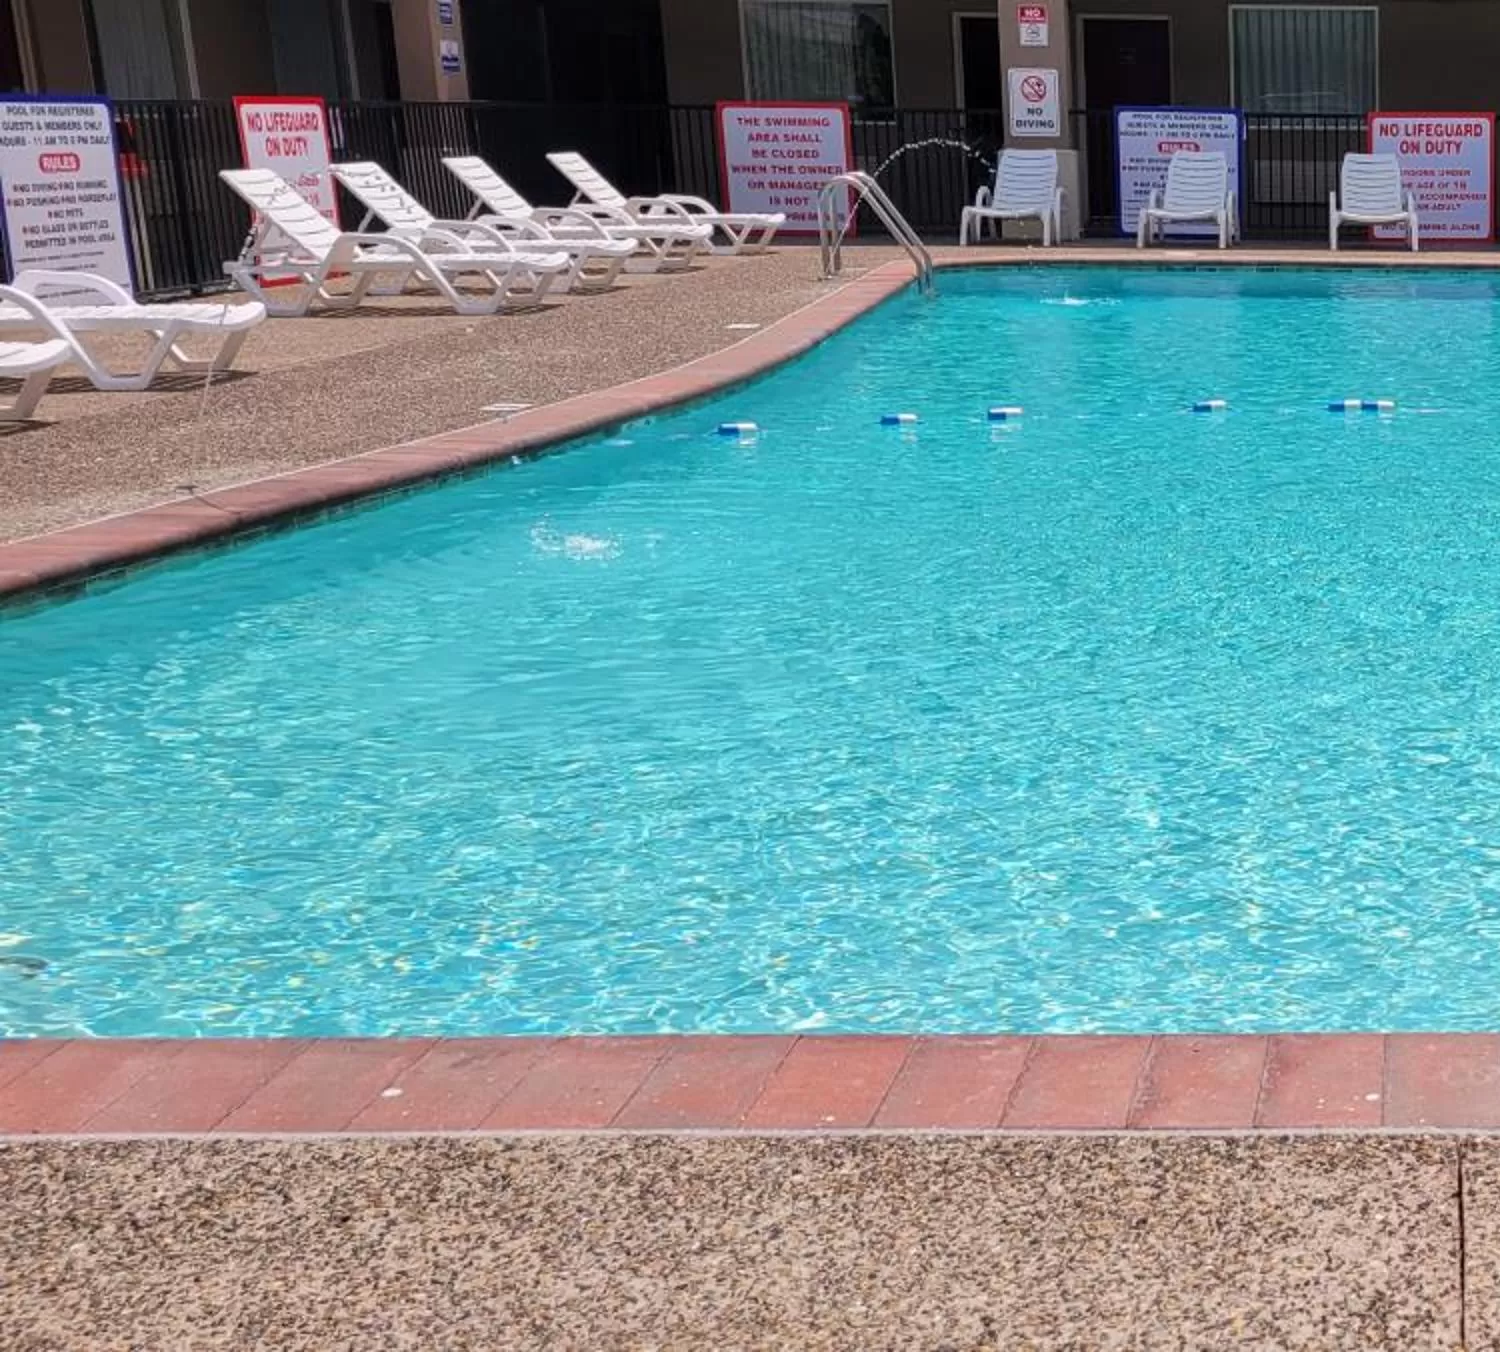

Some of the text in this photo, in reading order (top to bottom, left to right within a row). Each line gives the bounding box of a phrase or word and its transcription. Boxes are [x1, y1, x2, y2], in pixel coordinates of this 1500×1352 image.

[6, 106, 28, 116] POOL
[1027, 107, 1043, 116] NO
[2, 121, 34, 131] GUESTS
[44, 121, 82, 130] MEMBERS
[247, 111, 320, 132] NO LIFEGUARD
[737, 117, 831, 127] THE SWIMMING
[1016, 120, 1054, 128] DIVING
[1380, 124, 1482, 136] NO LIFEGUARD
[748, 133, 822, 142] AREA SHALL
[265, 137, 310, 156] ON DUTY
[1400, 141, 1463, 154] ON DUTY
[752, 149, 820, 158] BE CLOSED
[42, 156, 78, 171] RULES
[732, 165, 843, 174] WHEN THE OWNER
[748, 182, 764, 190] OR
[1417, 181, 1433, 189] AGE
[769, 196, 809, 206] IS NOT
